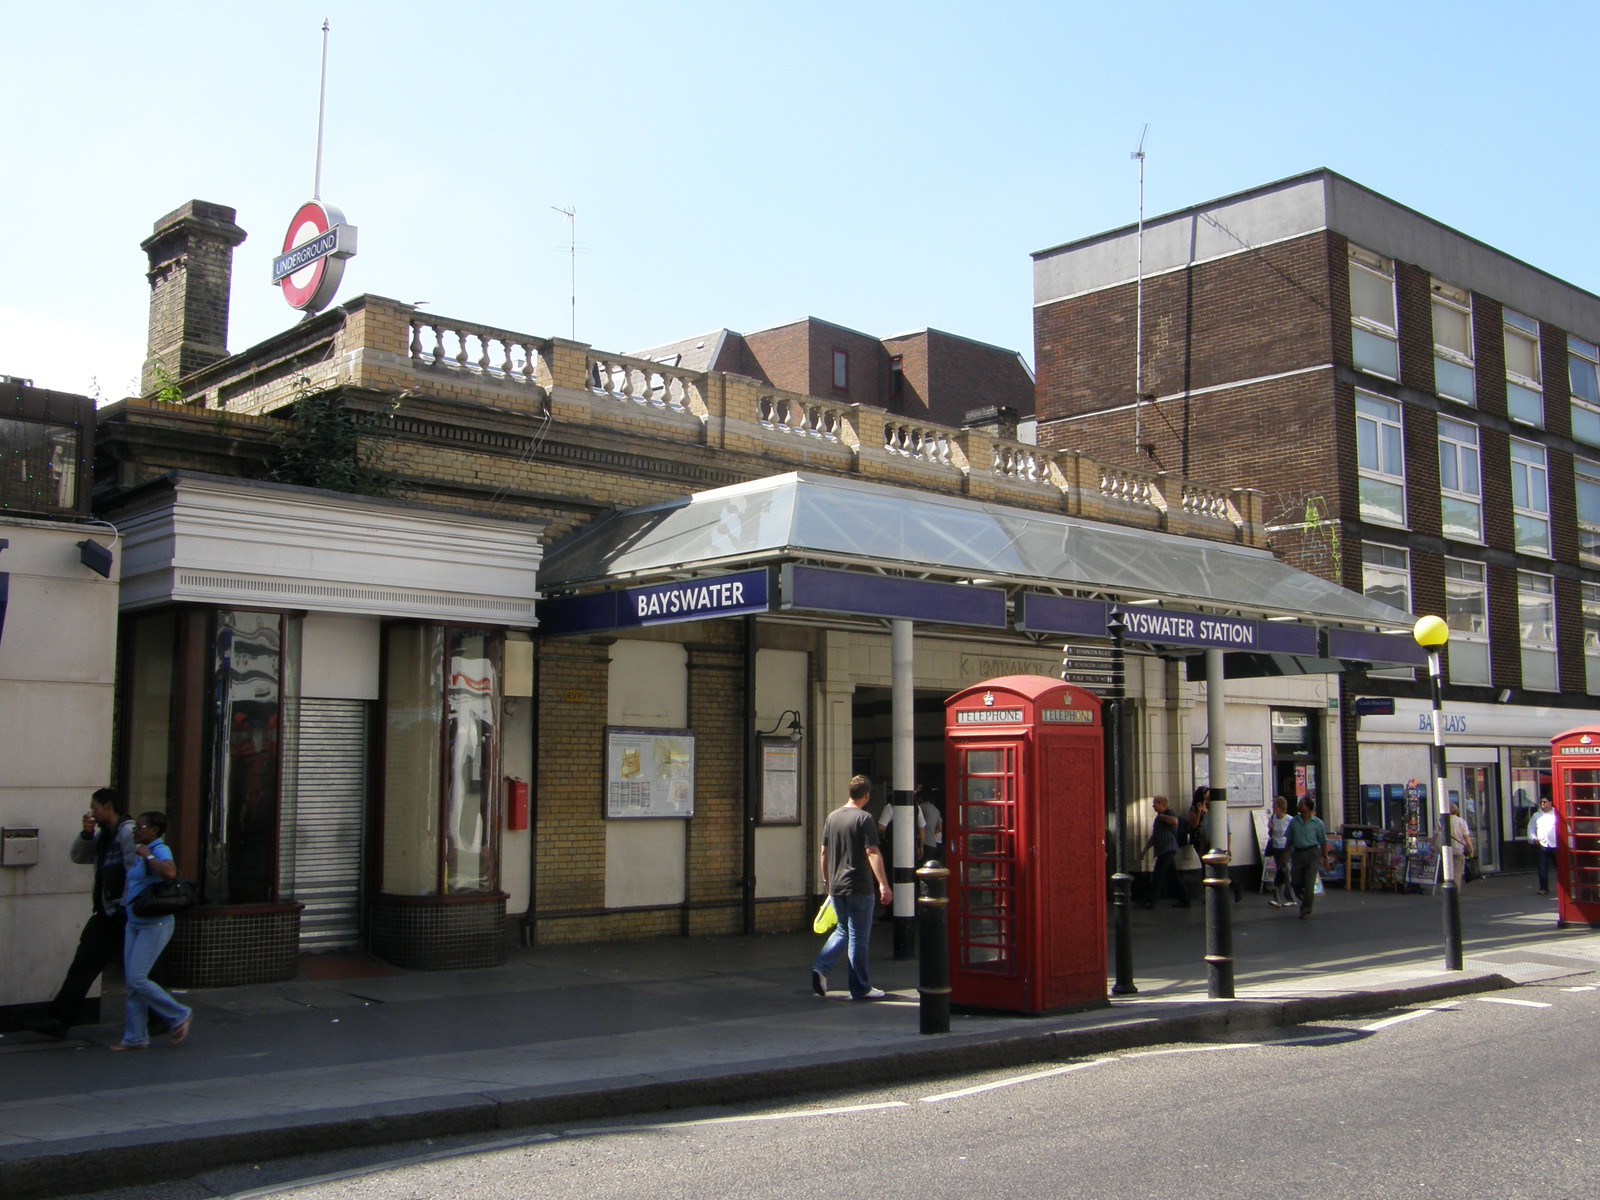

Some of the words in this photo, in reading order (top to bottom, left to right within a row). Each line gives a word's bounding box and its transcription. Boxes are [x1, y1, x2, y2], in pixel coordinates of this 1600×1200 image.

[276, 234, 335, 275] UNDERGROUND
[638, 582, 744, 617] BAYSWATER
[1122, 612, 1195, 638] AYSWATER
[1200, 620, 1253, 644] STATION
[566, 691, 583, 700] RVP
[960, 709, 1021, 722] TELEPHONE
[1043, 709, 1092, 722] TELEPHONE
[1418, 713, 1467, 732] BALAYS
